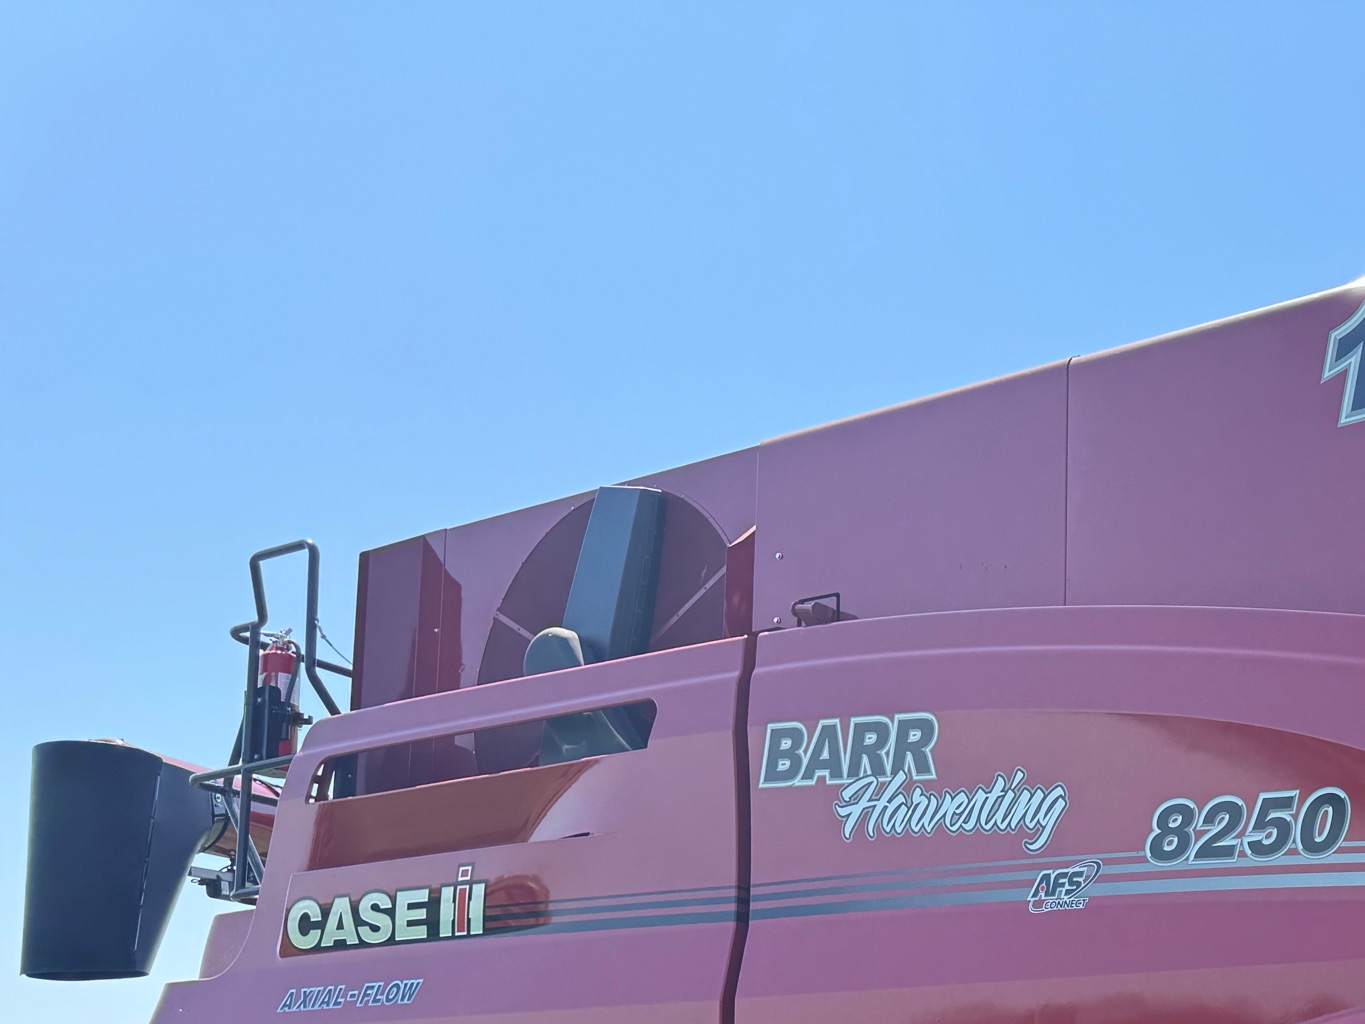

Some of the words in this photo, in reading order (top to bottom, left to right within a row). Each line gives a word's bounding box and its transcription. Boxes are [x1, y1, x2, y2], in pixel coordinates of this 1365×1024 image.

[758, 710, 939, 790] BARR
[833, 765, 1069, 853] Harvesting
[1144, 785, 1351, 866] 8250
[1027, 868, 1088, 901] AFS
[1044, 897, 1089, 910] CONNECT
[285, 885, 431, 950] CASE
[277, 978, 424, 1013] AXIAL-FLOW
